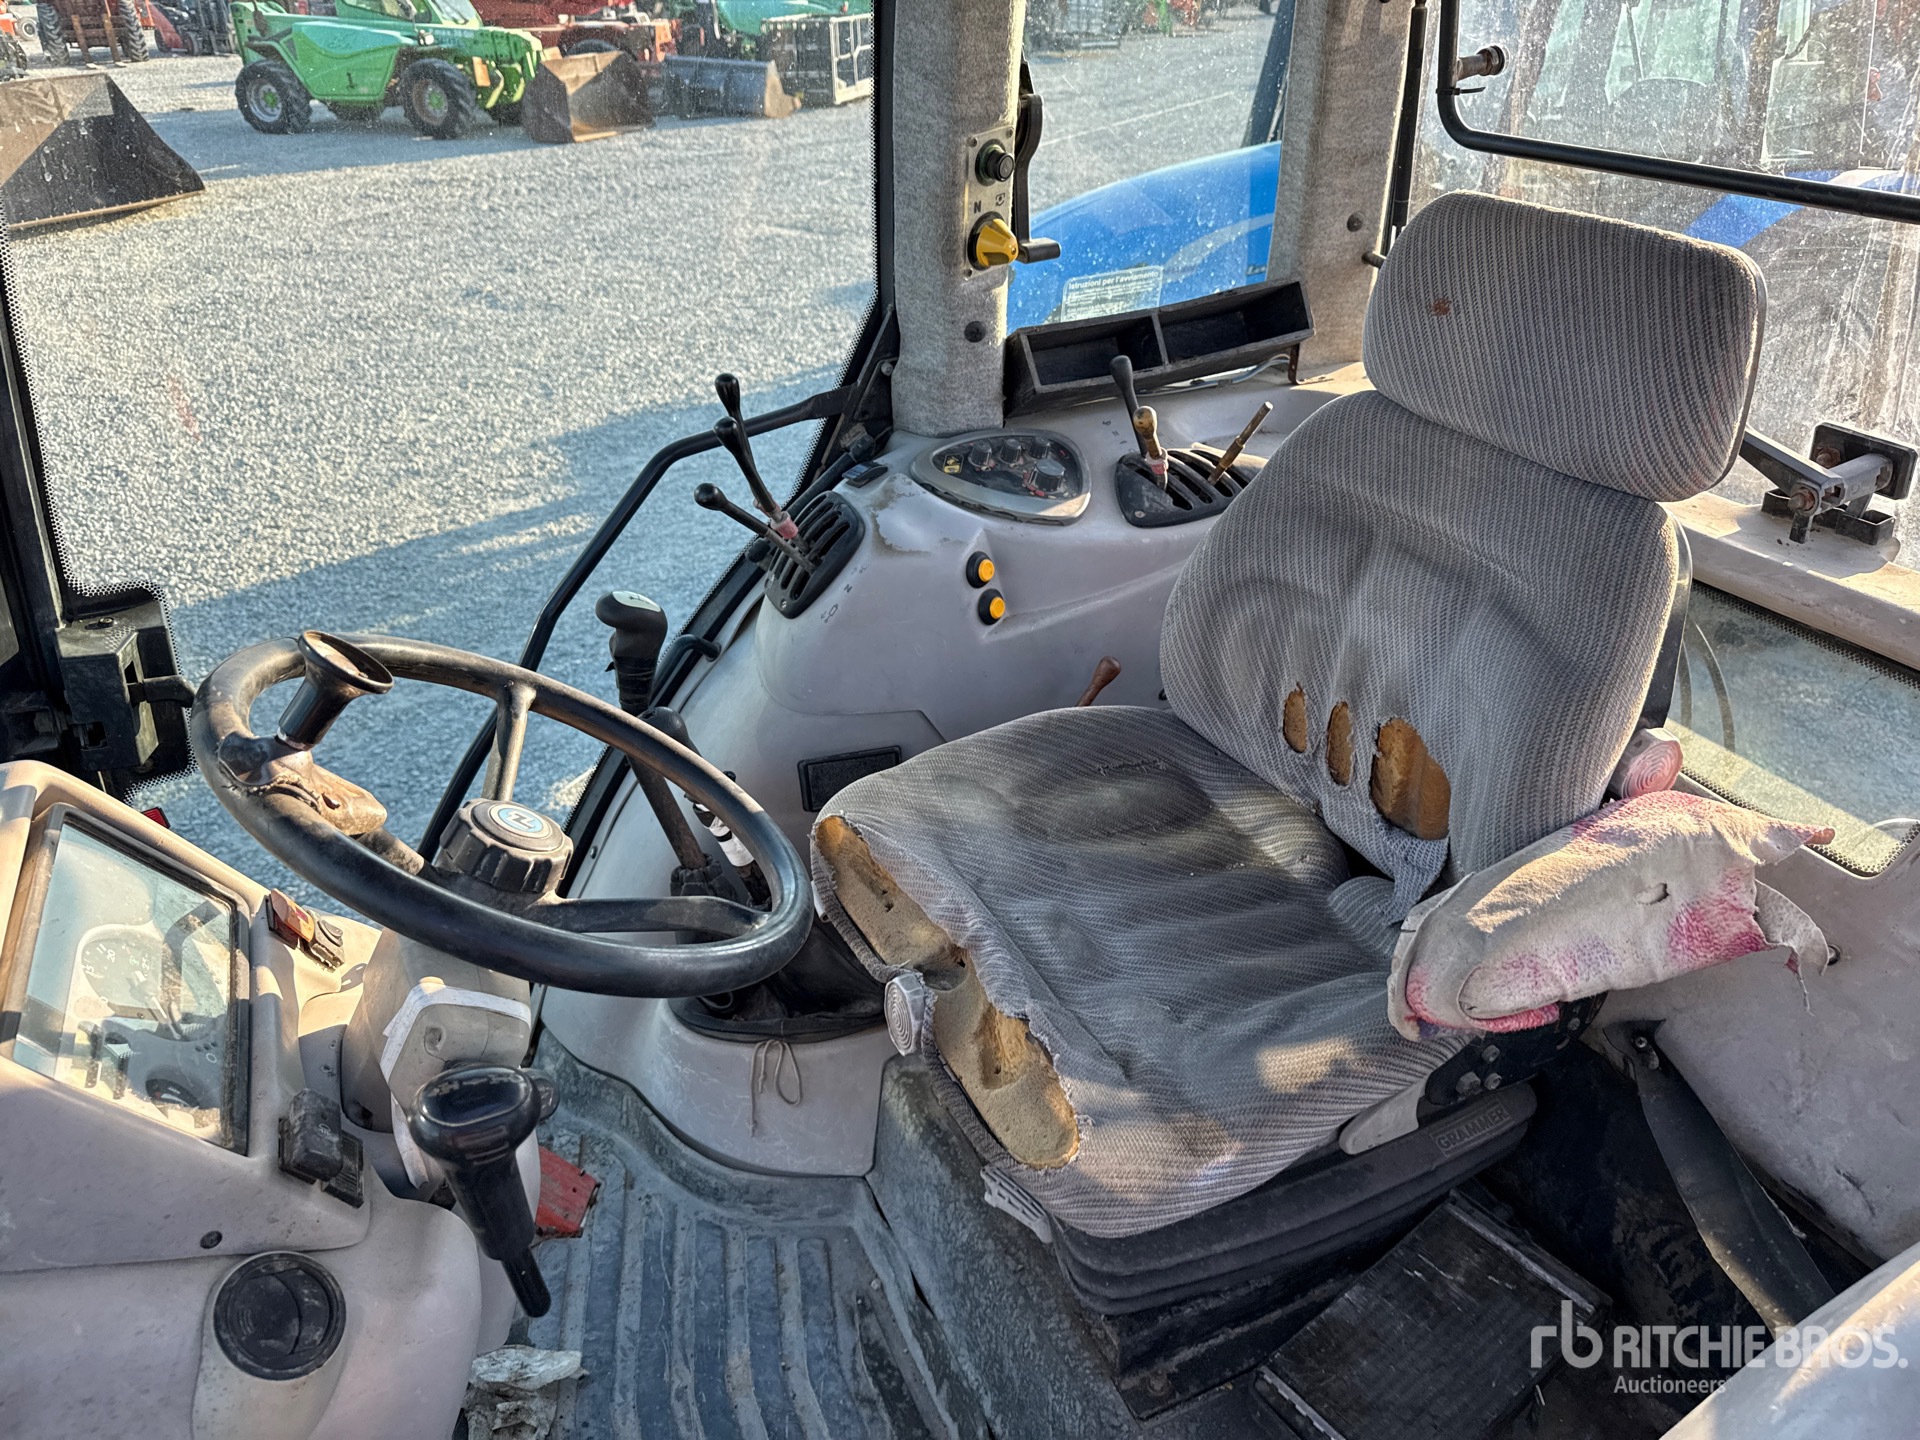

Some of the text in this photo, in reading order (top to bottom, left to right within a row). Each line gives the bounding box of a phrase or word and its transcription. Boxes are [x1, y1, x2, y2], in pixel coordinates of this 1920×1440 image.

[973, 200, 982, 214] N
[1102, 277, 1114, 285] per
[1437, 1109, 1510, 1150] GRAMMER
